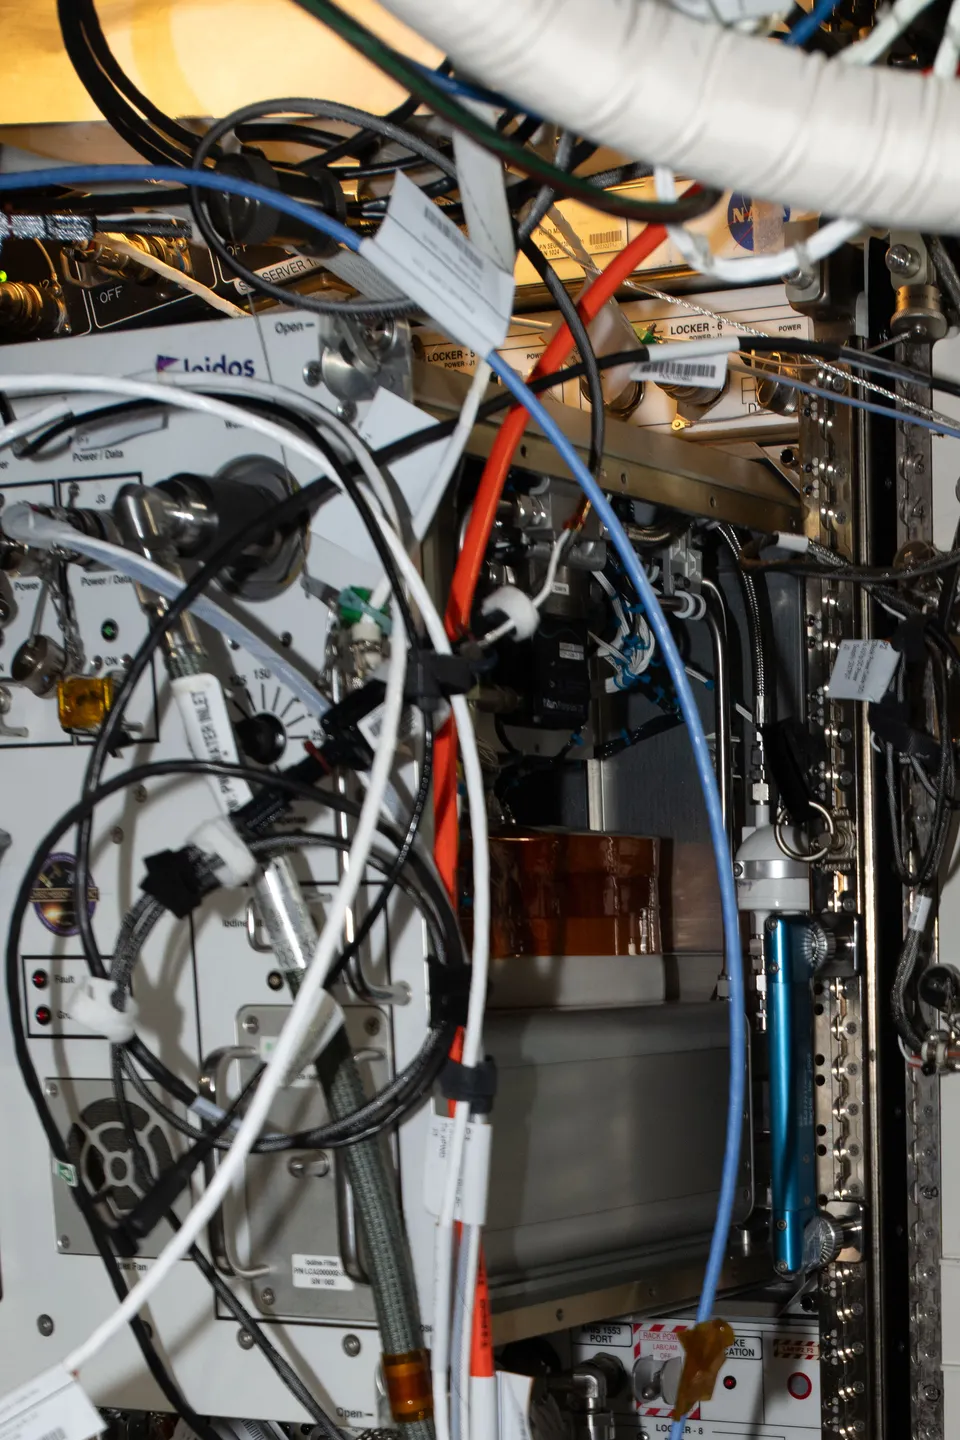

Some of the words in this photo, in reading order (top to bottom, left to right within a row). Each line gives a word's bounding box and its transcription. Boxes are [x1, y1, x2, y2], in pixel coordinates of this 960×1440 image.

[260, 258, 306, 284] SERVER
[99, 285, 122, 303] OFF
[274, 321, 304, 335] Open
[670, 322, 711, 335] LOCKER
[715, 322, 723, 332] 6
[778, 324, 802, 332] POWER
[427, 349, 463, 362] LOCKER
[469, 349, 475, 357] 5
[443, 360, 464, 368] POWER
[72, 451, 98, 461] Power
[104, 448, 124, 459] Data
[13, 580, 39, 591] Power
[80, 576, 106, 586] Power
[112, 574, 132, 583] Data
[104, 655, 118, 665] ON
[253, 668, 271, 679] 150
[188, 686, 214, 724] INLET
[54, 975, 74, 983] Fault
[131, 1262, 148, 1270] Fan
[603, 1325, 621, 1335] 1553
[589, 1334, 612, 1343] PORT
[642, 1331, 660, 1340] RACK
[662, 1332, 679, 1341] POW
[335, 1407, 363, 1420] Open
[655, 1423, 691, 1433] LOCER
[698, 1427, 703, 1435] 8
